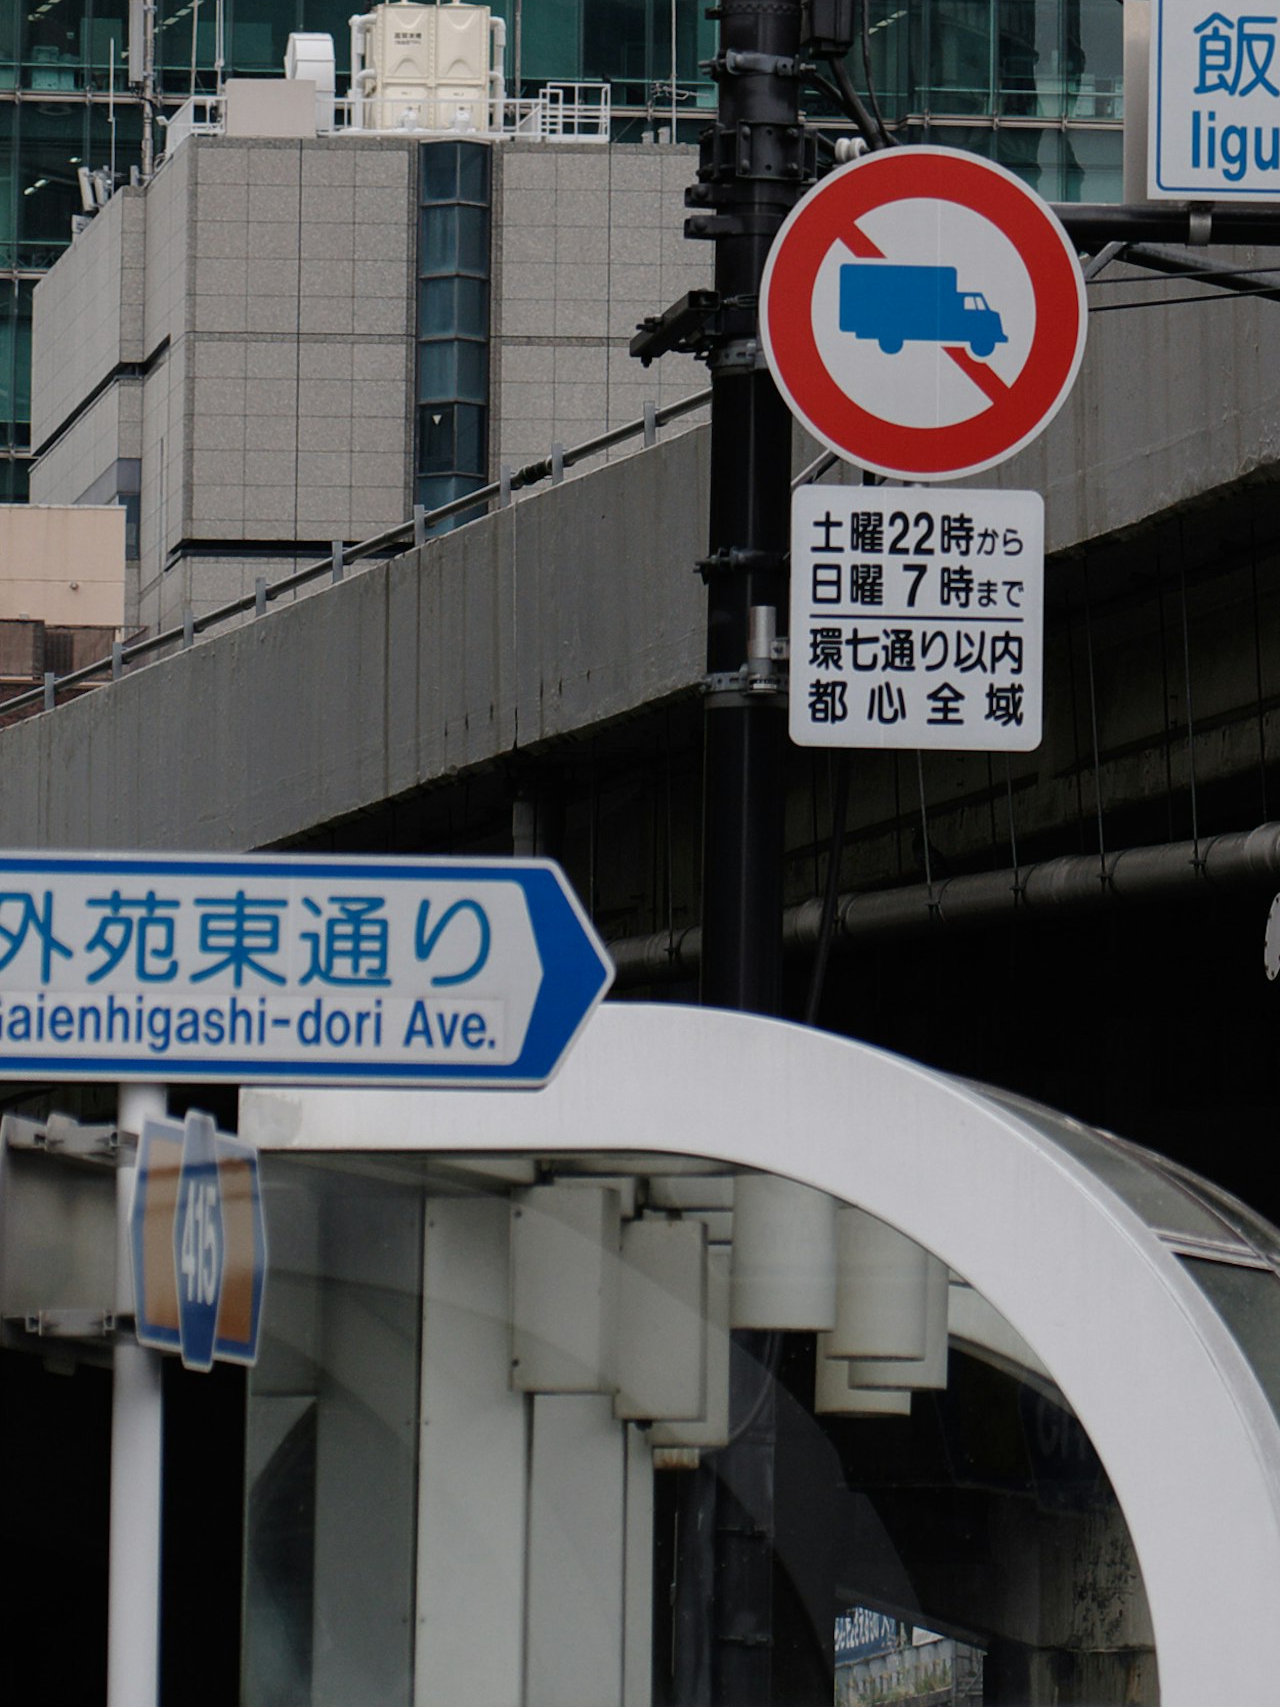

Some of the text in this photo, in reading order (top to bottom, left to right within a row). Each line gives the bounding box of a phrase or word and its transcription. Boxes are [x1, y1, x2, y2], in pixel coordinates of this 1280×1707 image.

[810, 510, 1024, 557] 土曜22時から
[808, 627, 1024, 675] 環七通り以内
[807, 678, 1025, 727] 都心全域
[0, 890, 492, 989] 外苑東通り
[0, 994, 497, 1054] aienhigashi-dori Ave.
[181, 1179, 217, 1305] 415
